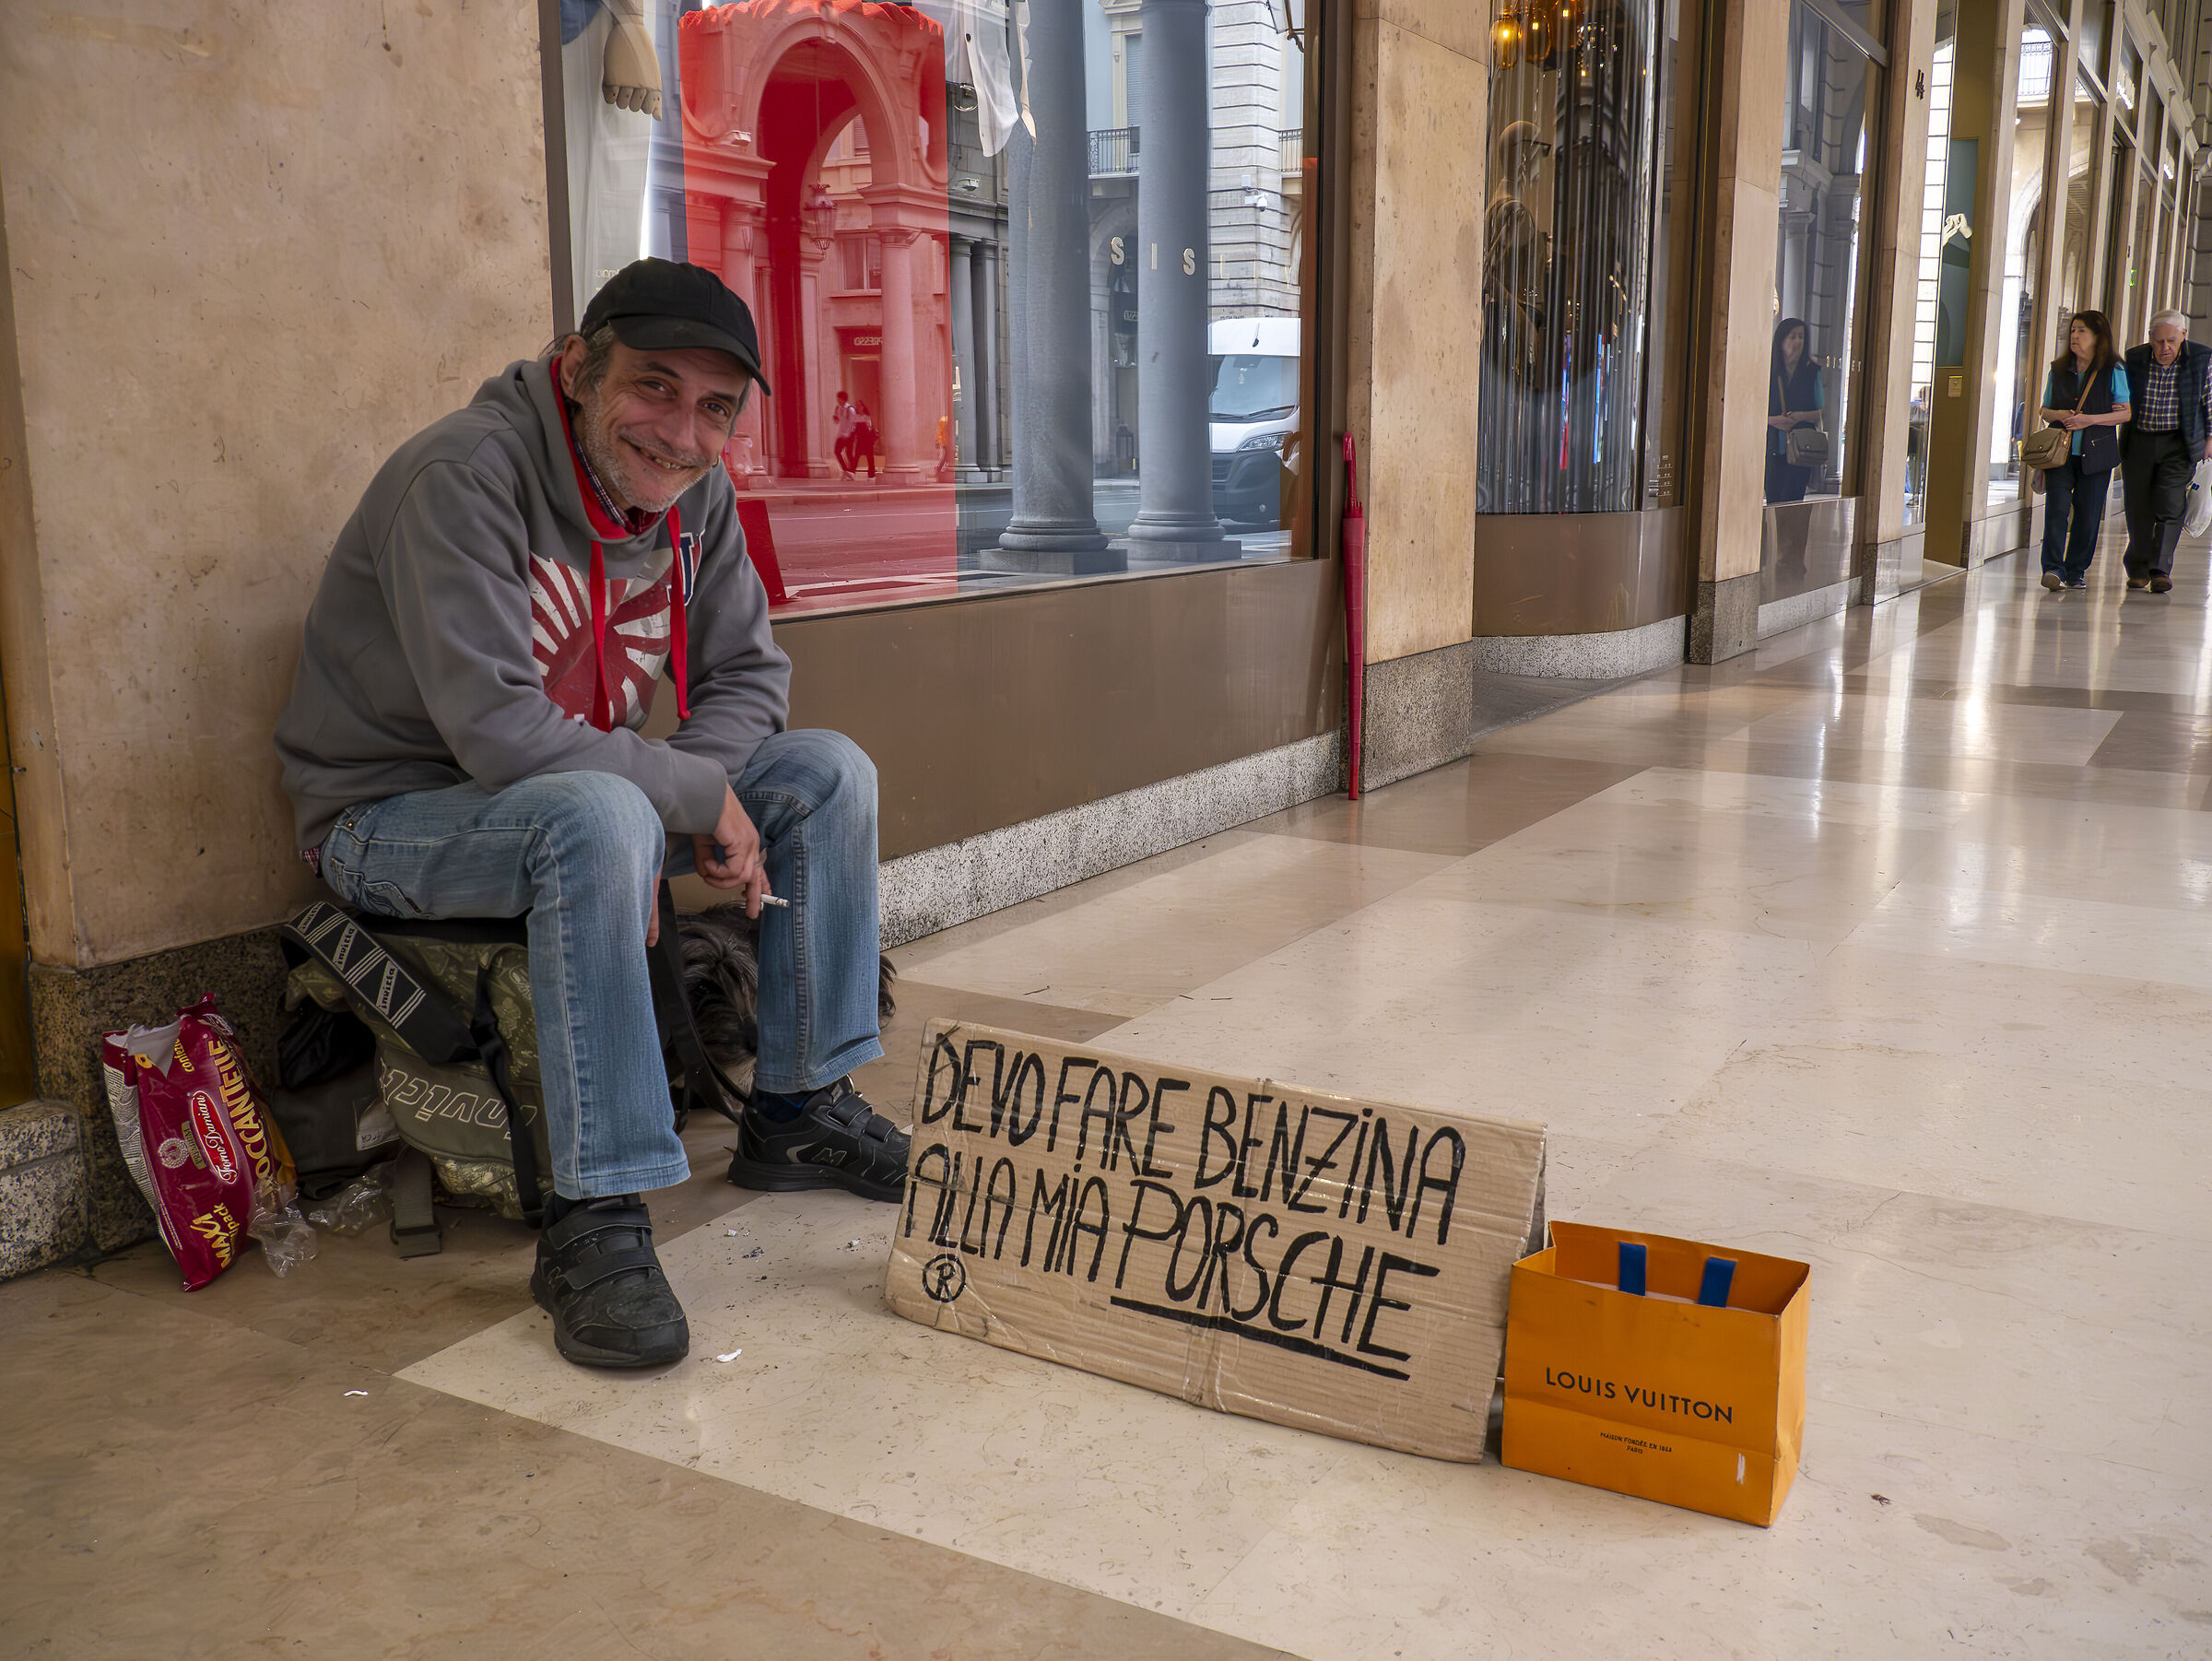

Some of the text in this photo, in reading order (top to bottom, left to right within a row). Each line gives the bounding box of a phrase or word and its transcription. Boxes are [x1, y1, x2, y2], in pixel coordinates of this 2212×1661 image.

[334, 927, 356, 965] invicta
[378, 967, 395, 1009] invicta
[196, 1095, 224, 1149] Damiani
[207, 1040, 271, 1185] OCCANTELLE
[921, 1032, 1466, 1245] DEVO FARE BENZINA
[904, 1143, 1017, 1260] ALLA
[1114, 1179, 1441, 1361] PORSCHE
[1546, 1367, 1734, 1425] LOUIS VUITTON
